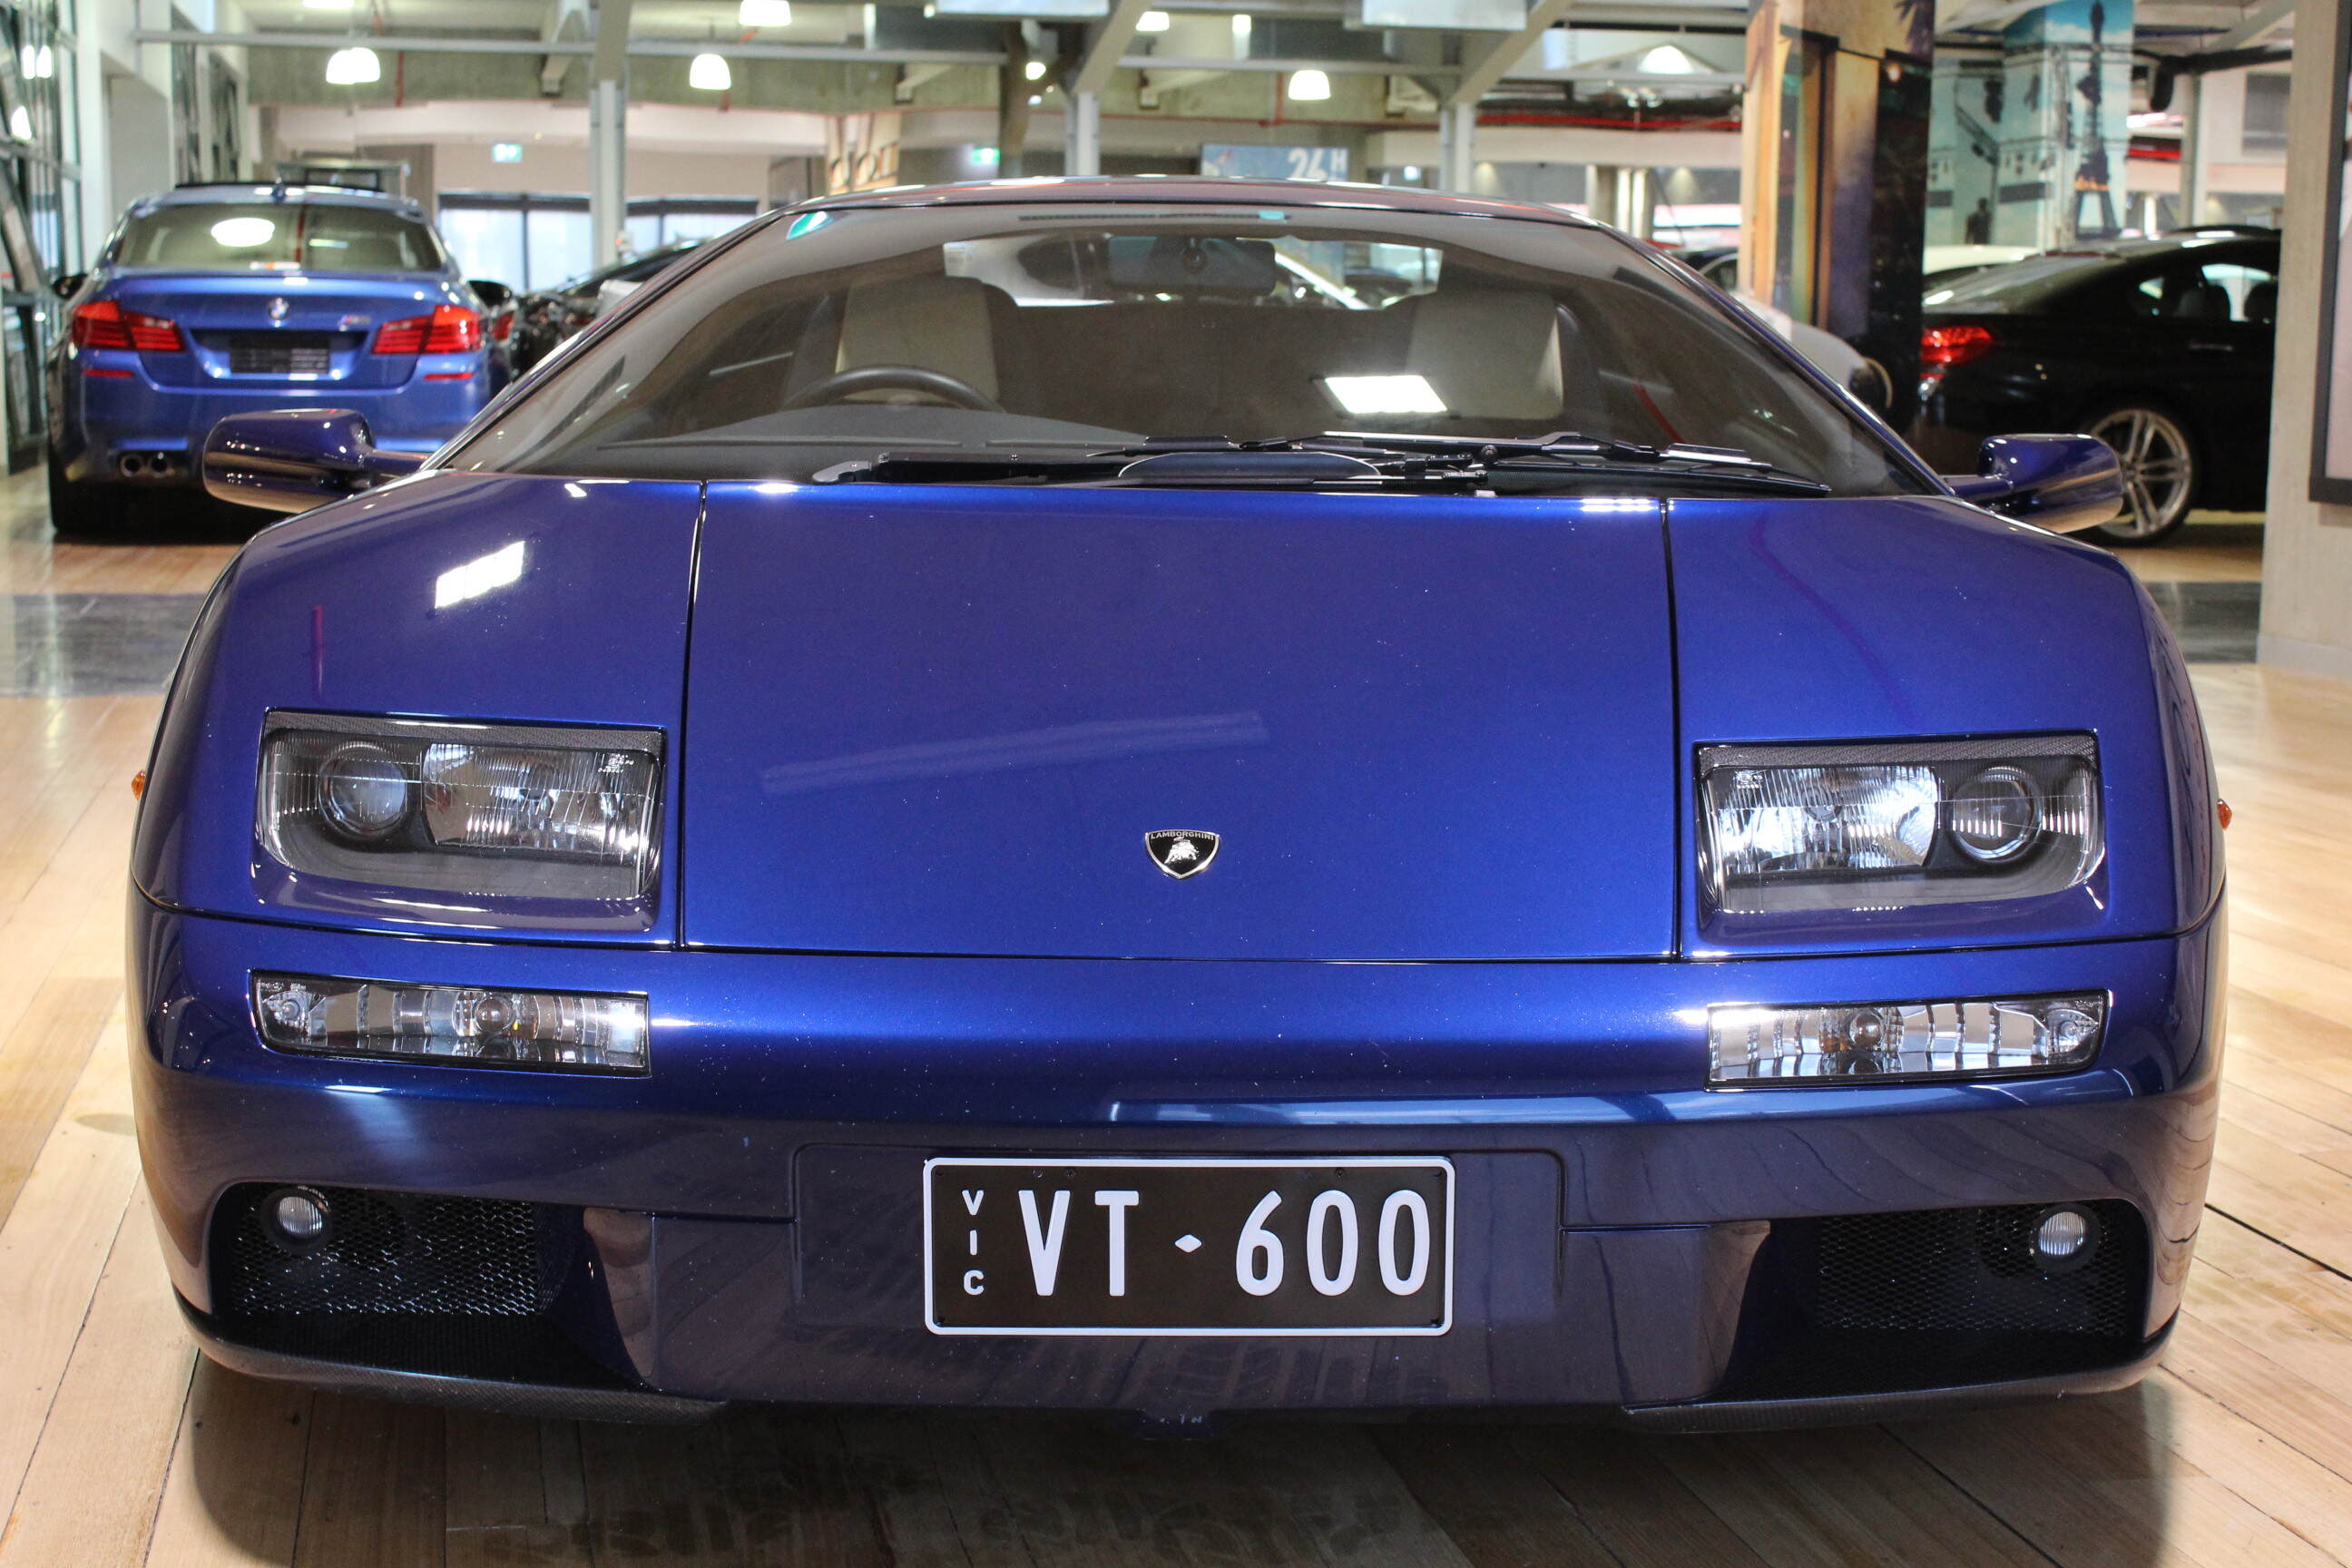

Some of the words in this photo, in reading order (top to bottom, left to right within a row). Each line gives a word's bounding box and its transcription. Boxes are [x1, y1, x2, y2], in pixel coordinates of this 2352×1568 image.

[1150, 831, 1214, 840] LAMBORGHINI
[962, 1190, 985, 1295] VIC
[1018, 1190, 1140, 1297] VT
[1236, 1190, 1431, 1297] 600
